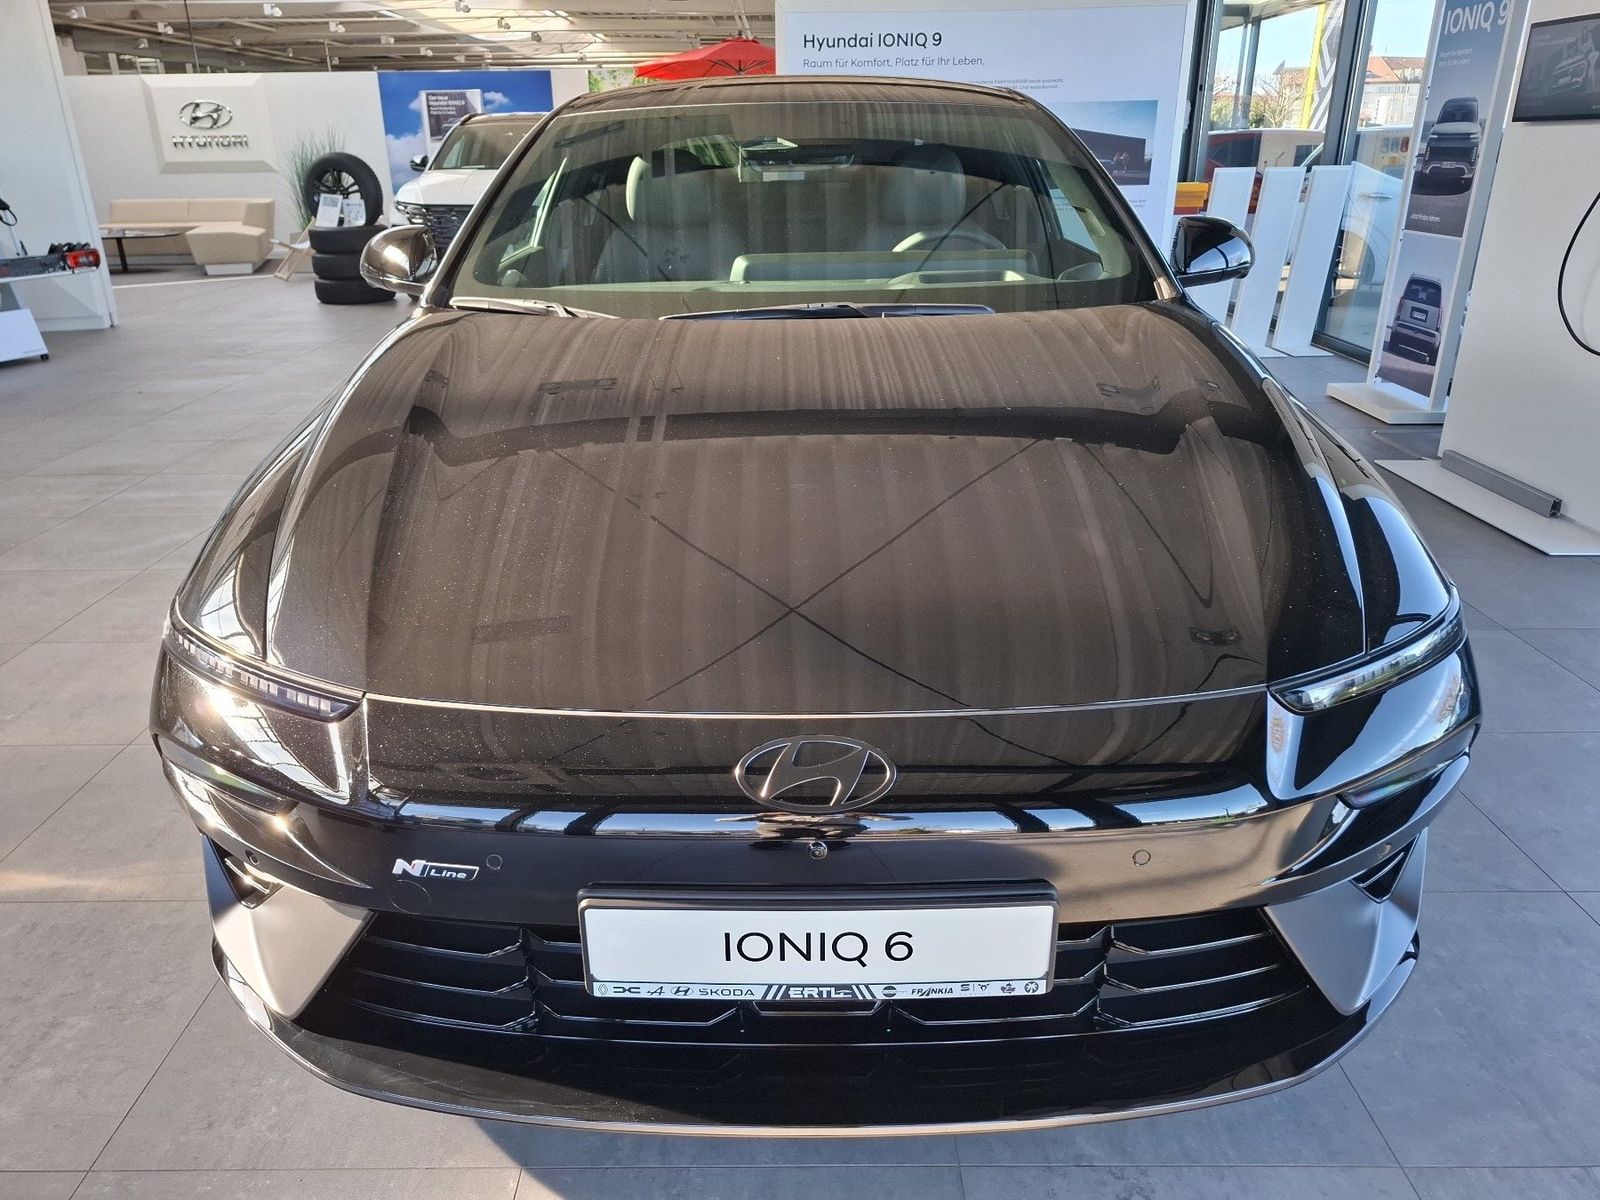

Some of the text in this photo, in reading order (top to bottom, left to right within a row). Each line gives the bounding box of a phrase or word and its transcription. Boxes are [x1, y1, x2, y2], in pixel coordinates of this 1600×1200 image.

[1444, 0, 1509, 35] IONIQ 9
[803, 32, 943, 51] Hyundai IONIQ 9
[803, 59, 833, 68] Raum
[835, 58, 849, 68] für
[895, 57, 919, 67] Platz
[922, 56, 935, 67] für
[937, 56, 950, 66] Ihr
[952, 56, 985, 67] Leben.
[172, 135, 248, 148] HYUNDAI
[392, 858, 467, 879] N Line
[724, 931, 914, 968] IONIQ 6
[911, 987, 954, 997] FRANKIA
